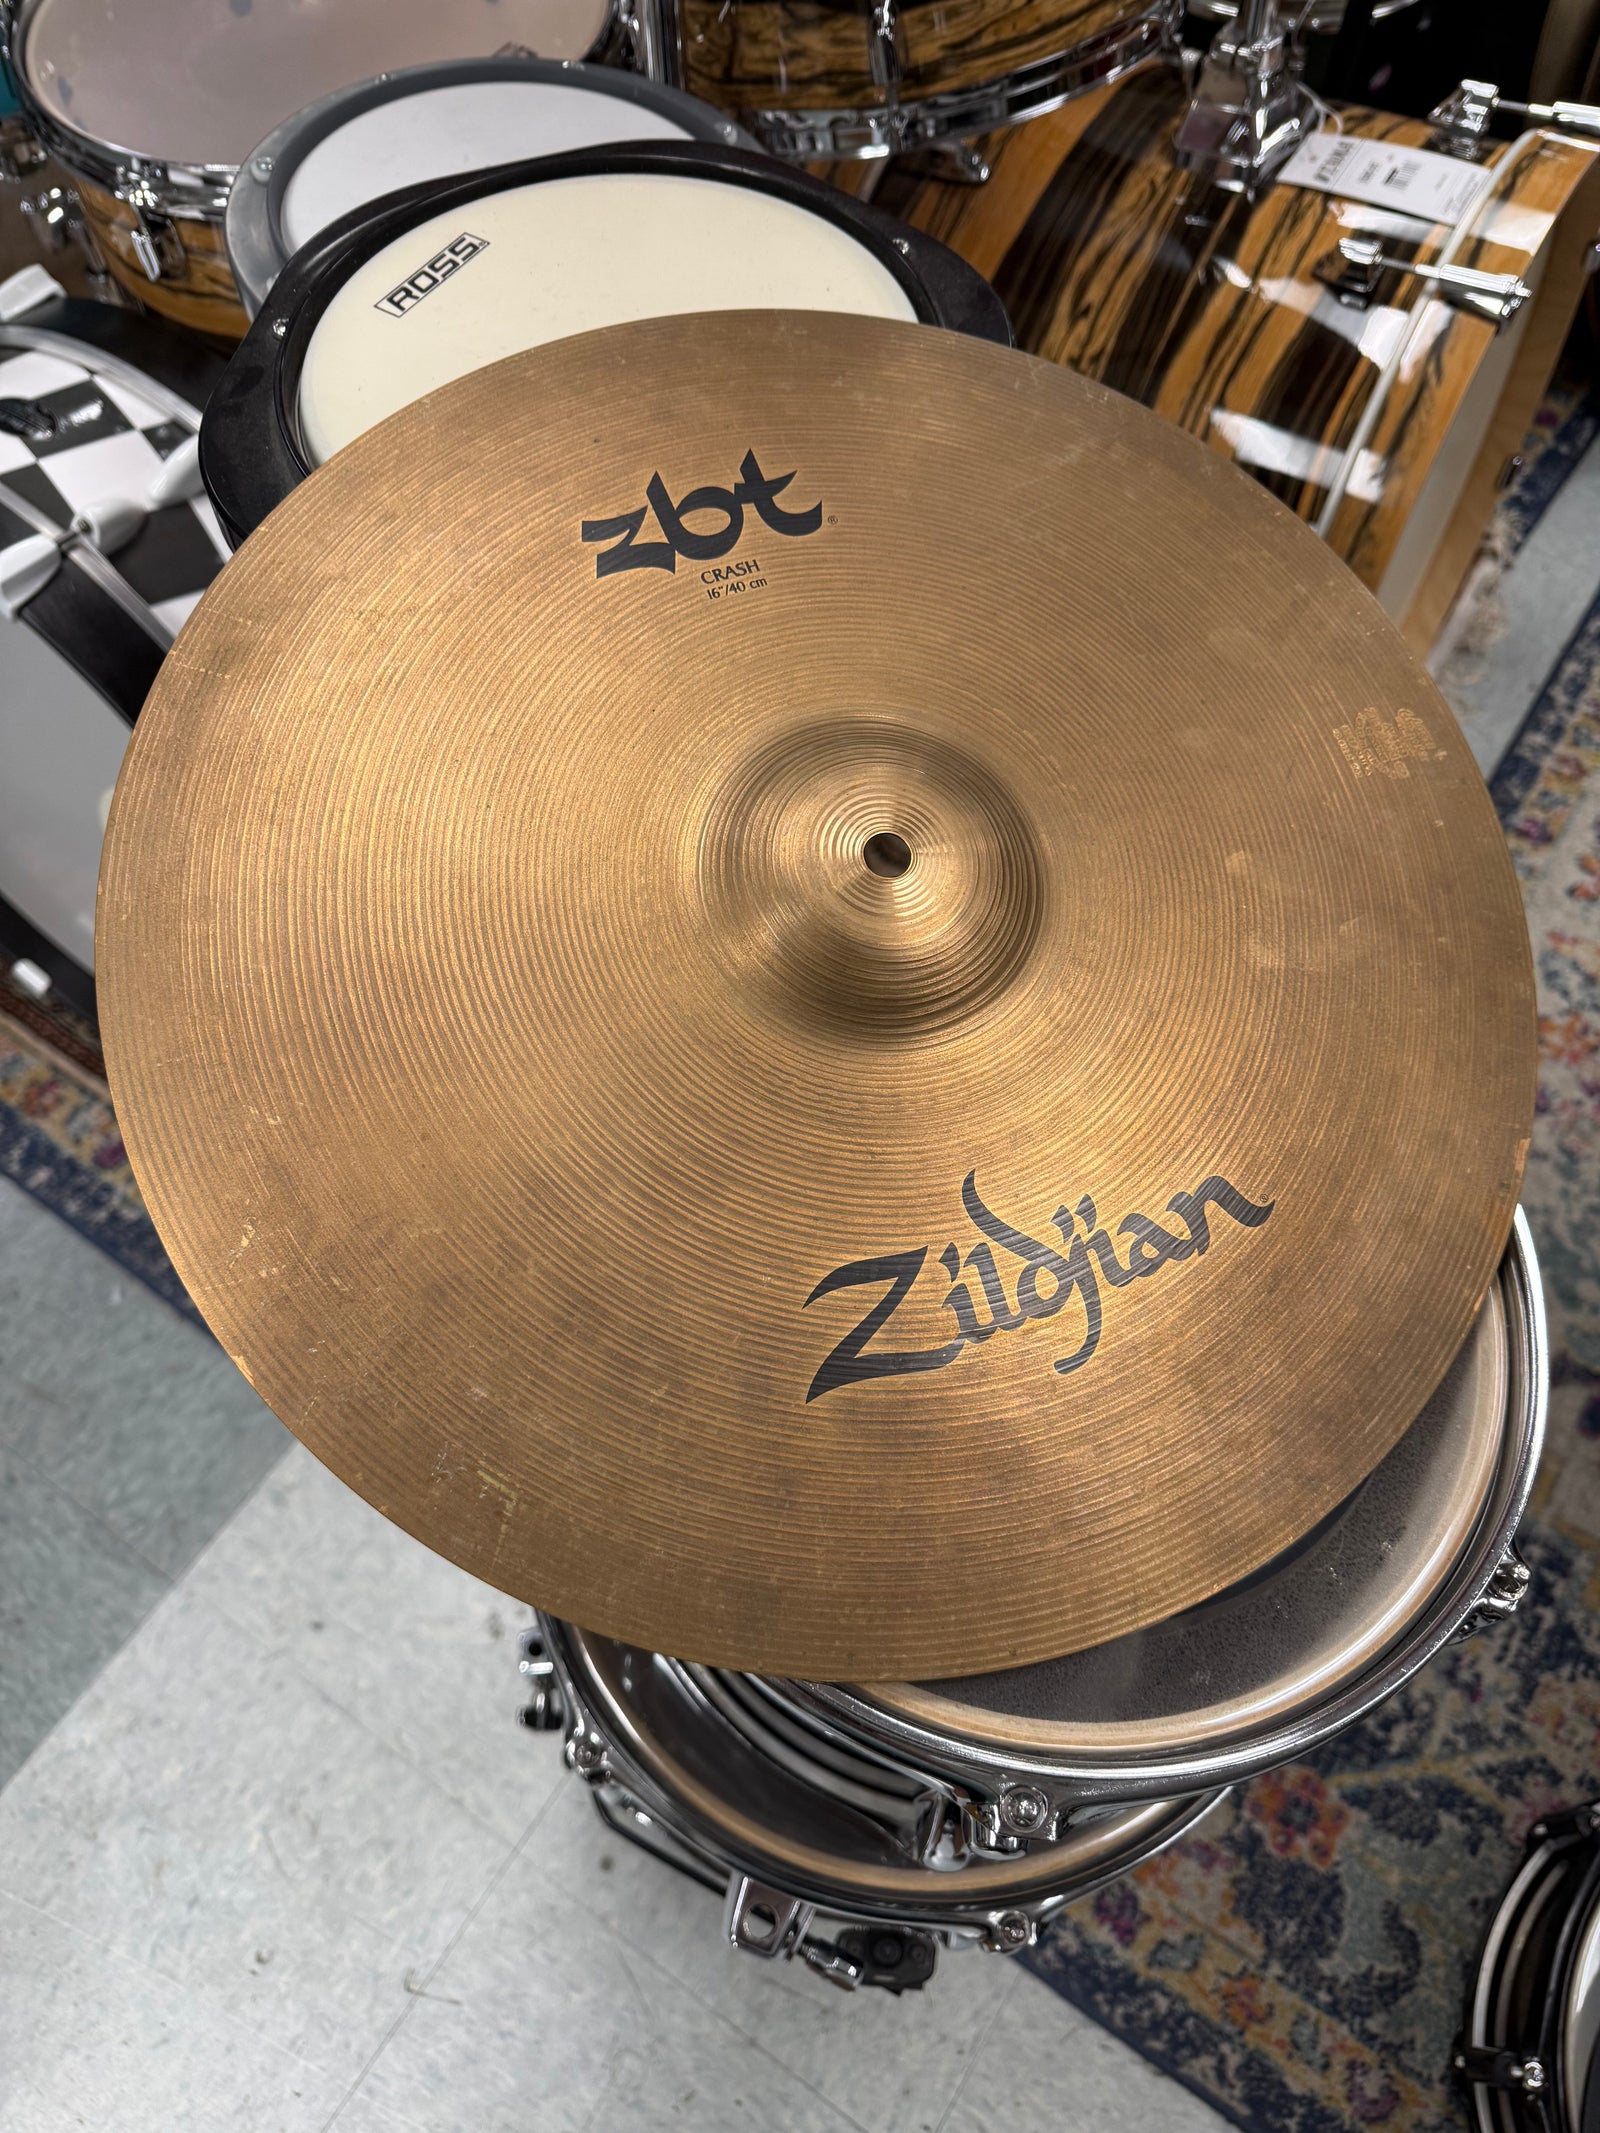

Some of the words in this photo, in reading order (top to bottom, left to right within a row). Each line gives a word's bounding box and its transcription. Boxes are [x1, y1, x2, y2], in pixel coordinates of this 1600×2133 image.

[386, 237, 480, 312] ROSS
[582, 448, 822, 579] zbt
[701, 559, 760, 585] CRASH
[749, 578, 768, 589] cm
[802, 1168, 1275, 1404] Zildjian
